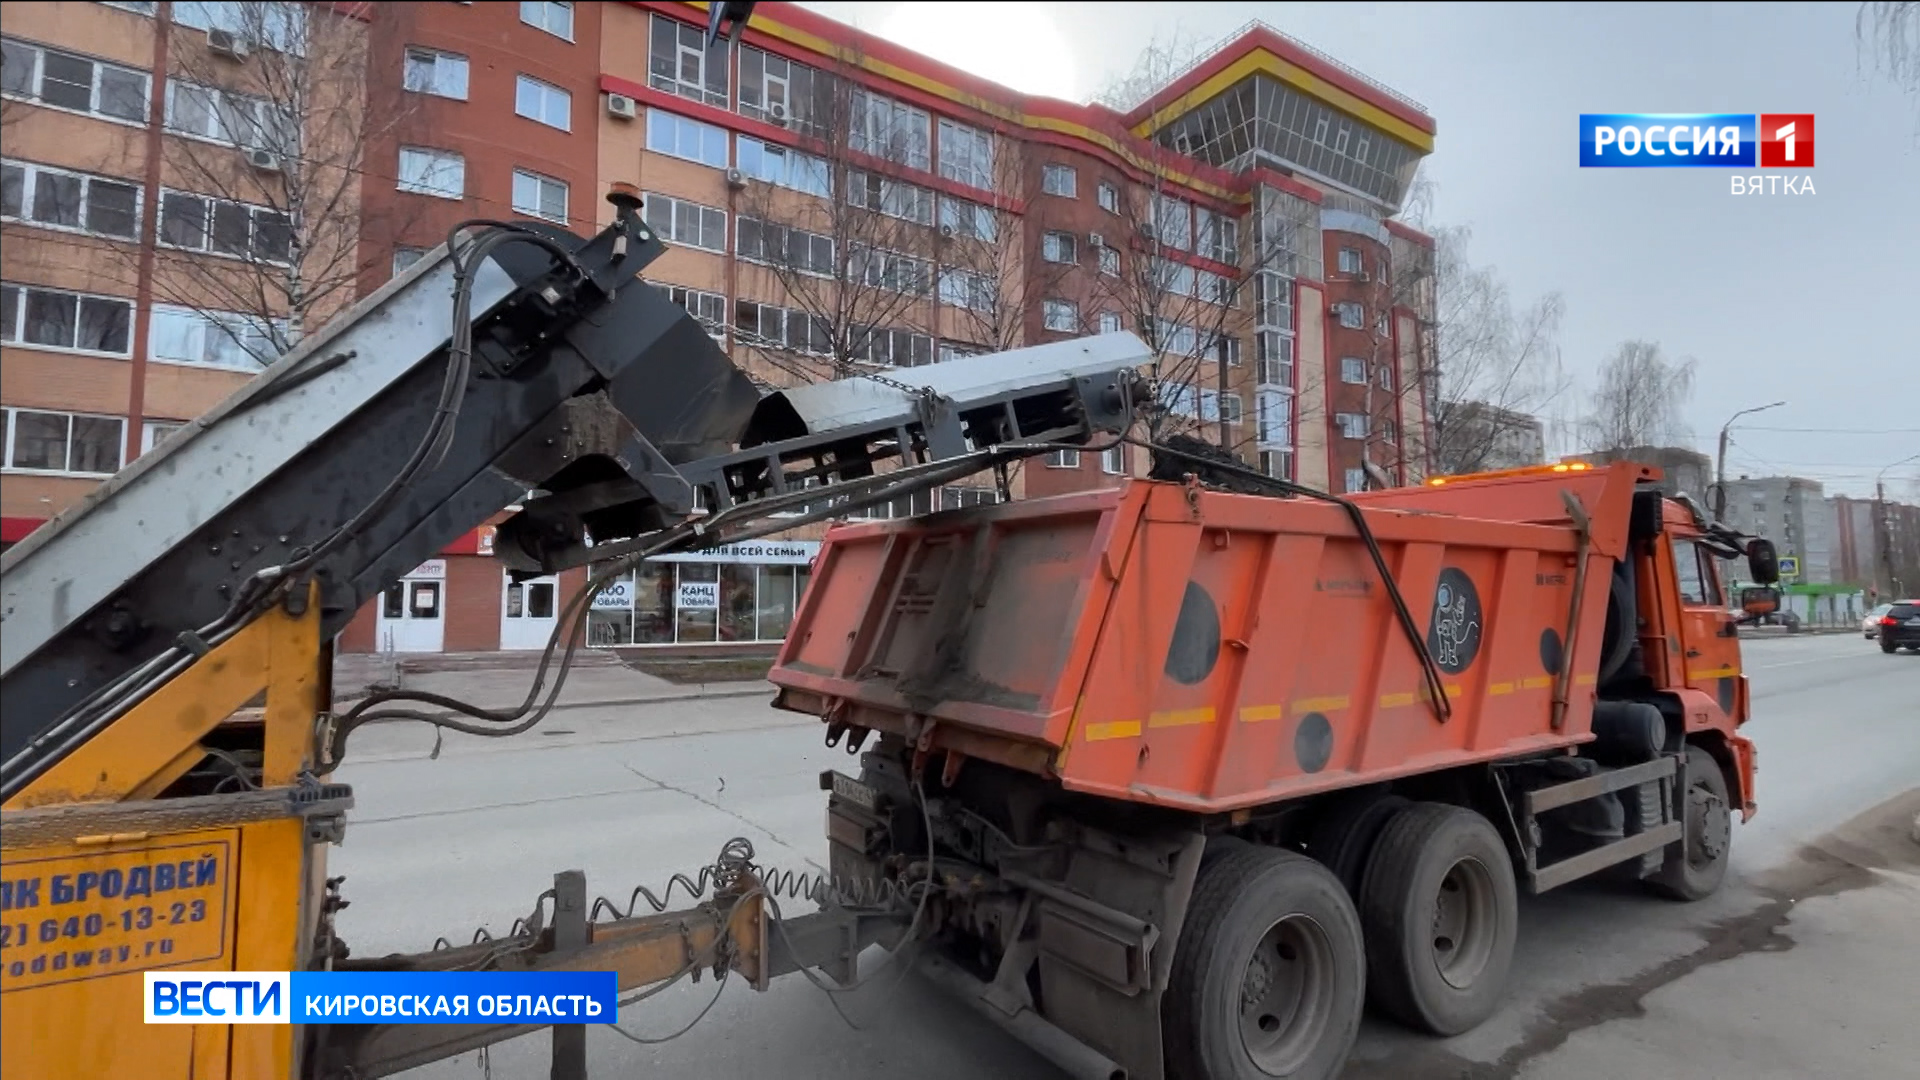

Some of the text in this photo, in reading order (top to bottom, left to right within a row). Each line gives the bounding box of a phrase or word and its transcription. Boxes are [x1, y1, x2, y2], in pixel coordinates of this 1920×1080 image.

[732, 545, 763, 556] ВСЕЙ
[766, 547, 805, 556] СЕМЬИ
[681, 585, 714, 597] КАНЦ
[593, 597, 630, 607] ОВАРЫ
[681, 597, 715, 607] ТОВАРЫ
[50, 853, 217, 906] БРОДВЕЙ
[39, 898, 207, 944] 640-13-23
[1, 938, 174, 978] oddway.ru
